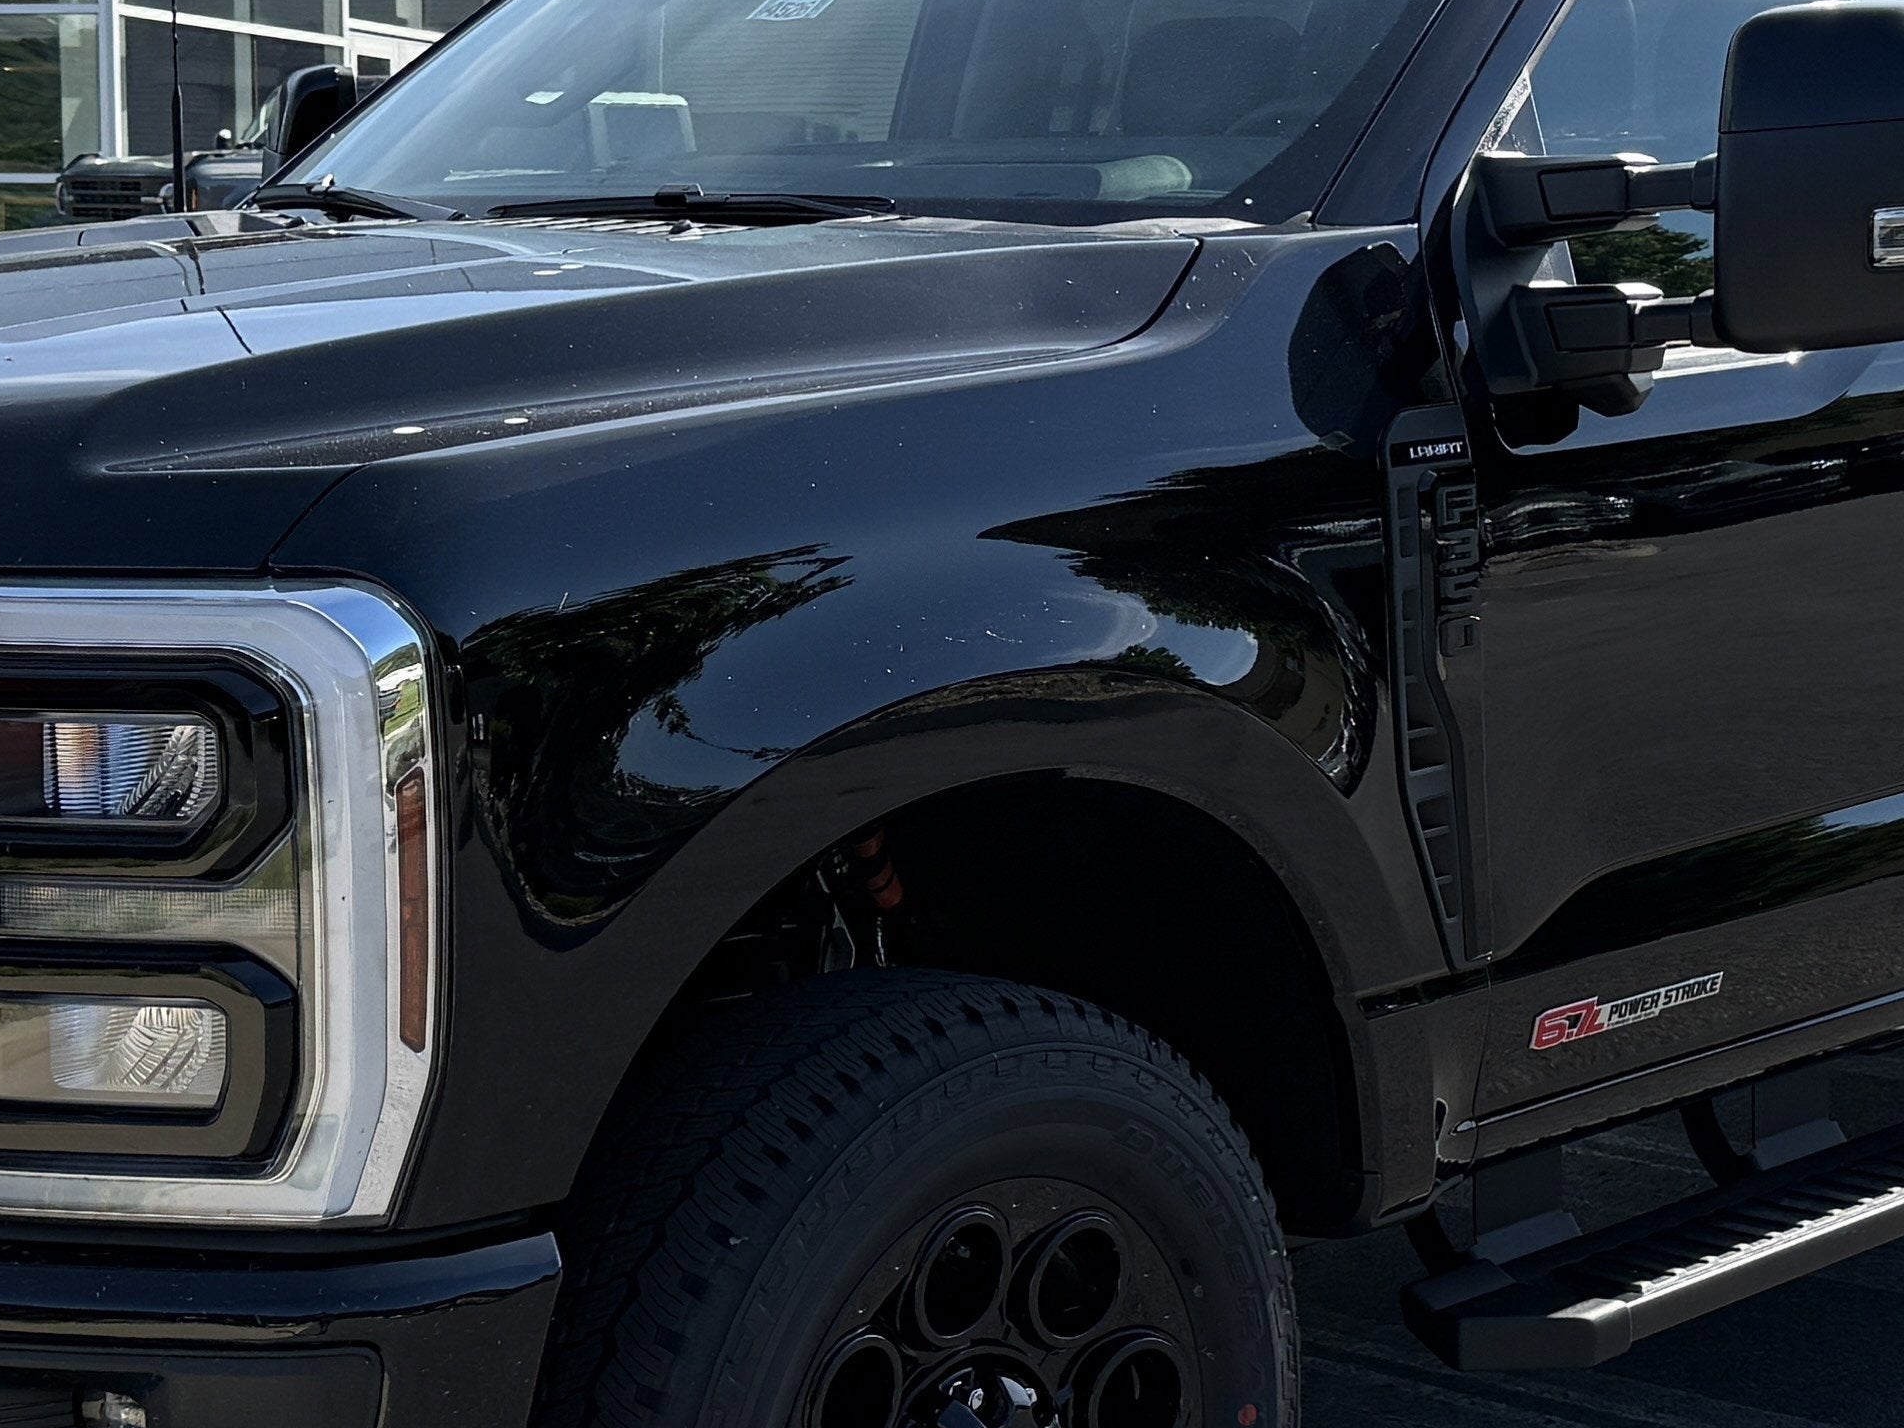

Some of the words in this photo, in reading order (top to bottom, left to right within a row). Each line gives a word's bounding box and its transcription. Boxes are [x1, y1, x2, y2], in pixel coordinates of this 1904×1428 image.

[1533, 999, 1605, 1049] 6.7L
[1608, 991, 1660, 1022] POWER
[1662, 975, 1721, 1006] STROKE
